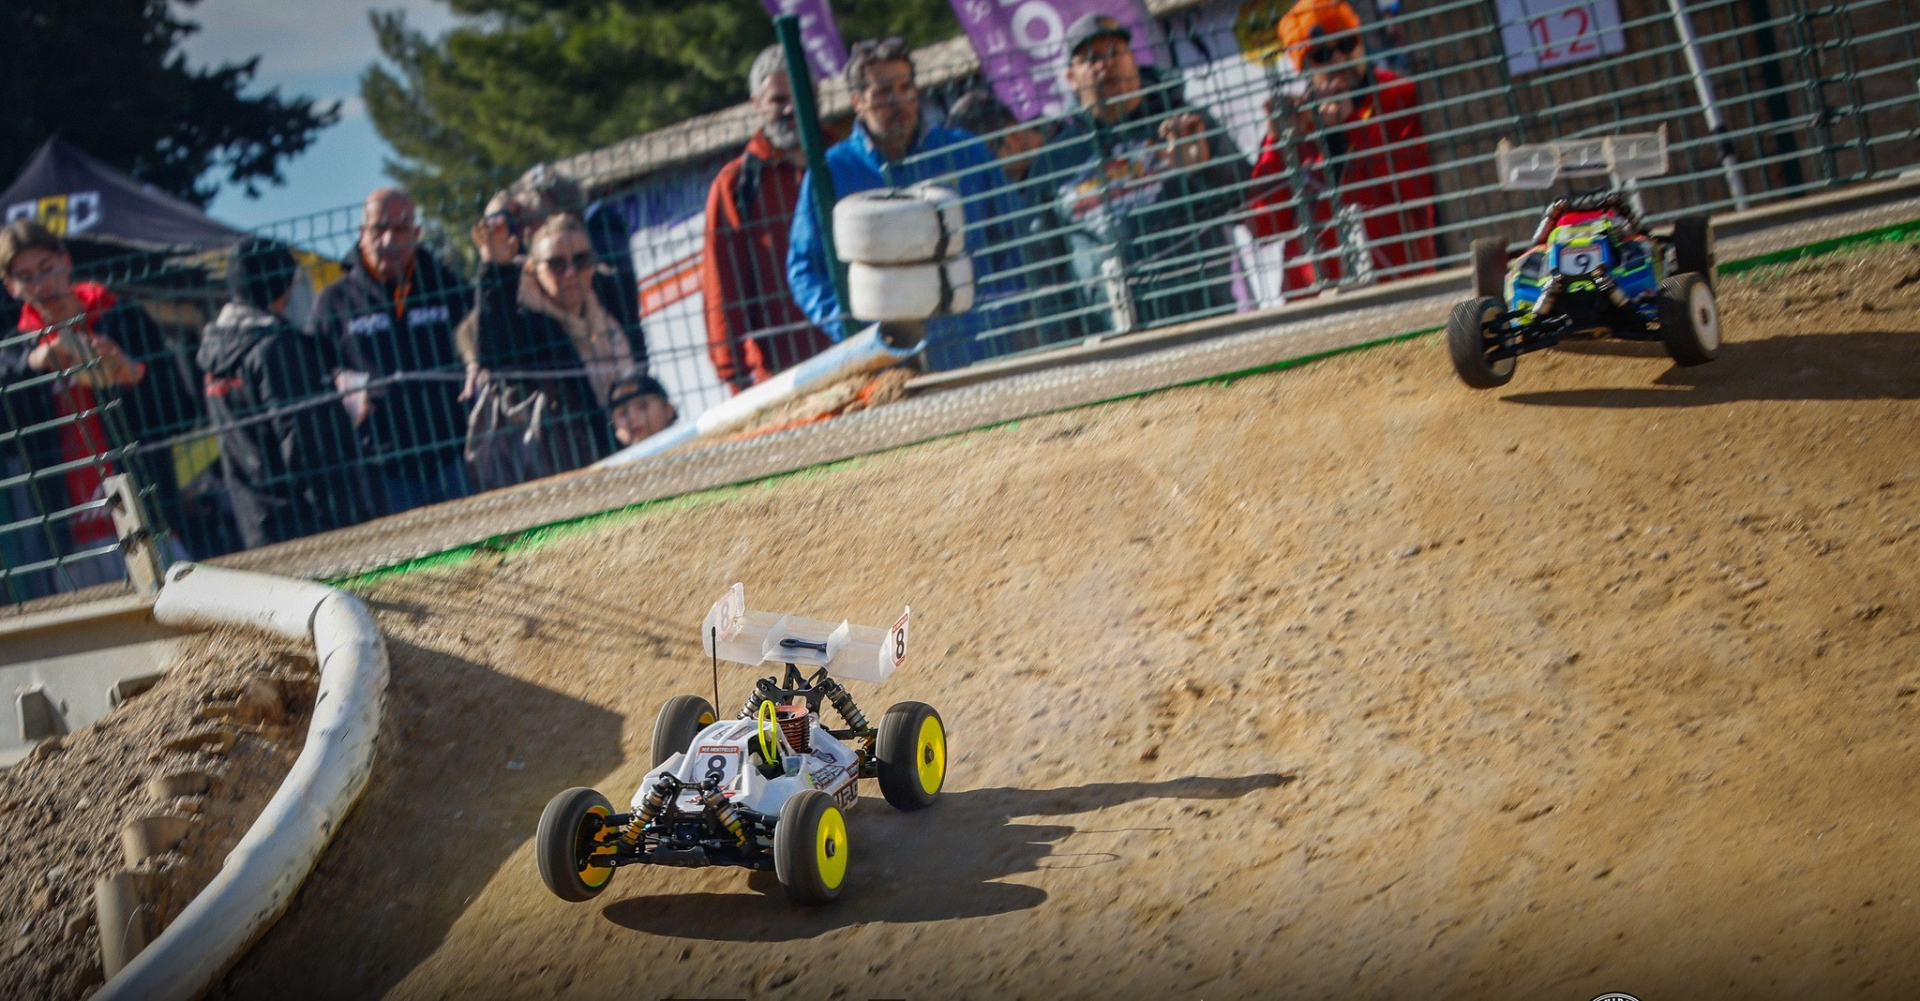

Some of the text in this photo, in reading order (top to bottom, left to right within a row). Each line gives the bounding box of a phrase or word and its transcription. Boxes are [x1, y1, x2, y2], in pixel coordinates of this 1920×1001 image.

[1530, 7, 1597, 60] 12
[1575, 254, 1590, 274] 9
[896, 628, 904, 659] 8
[705, 755, 727, 783] 8
